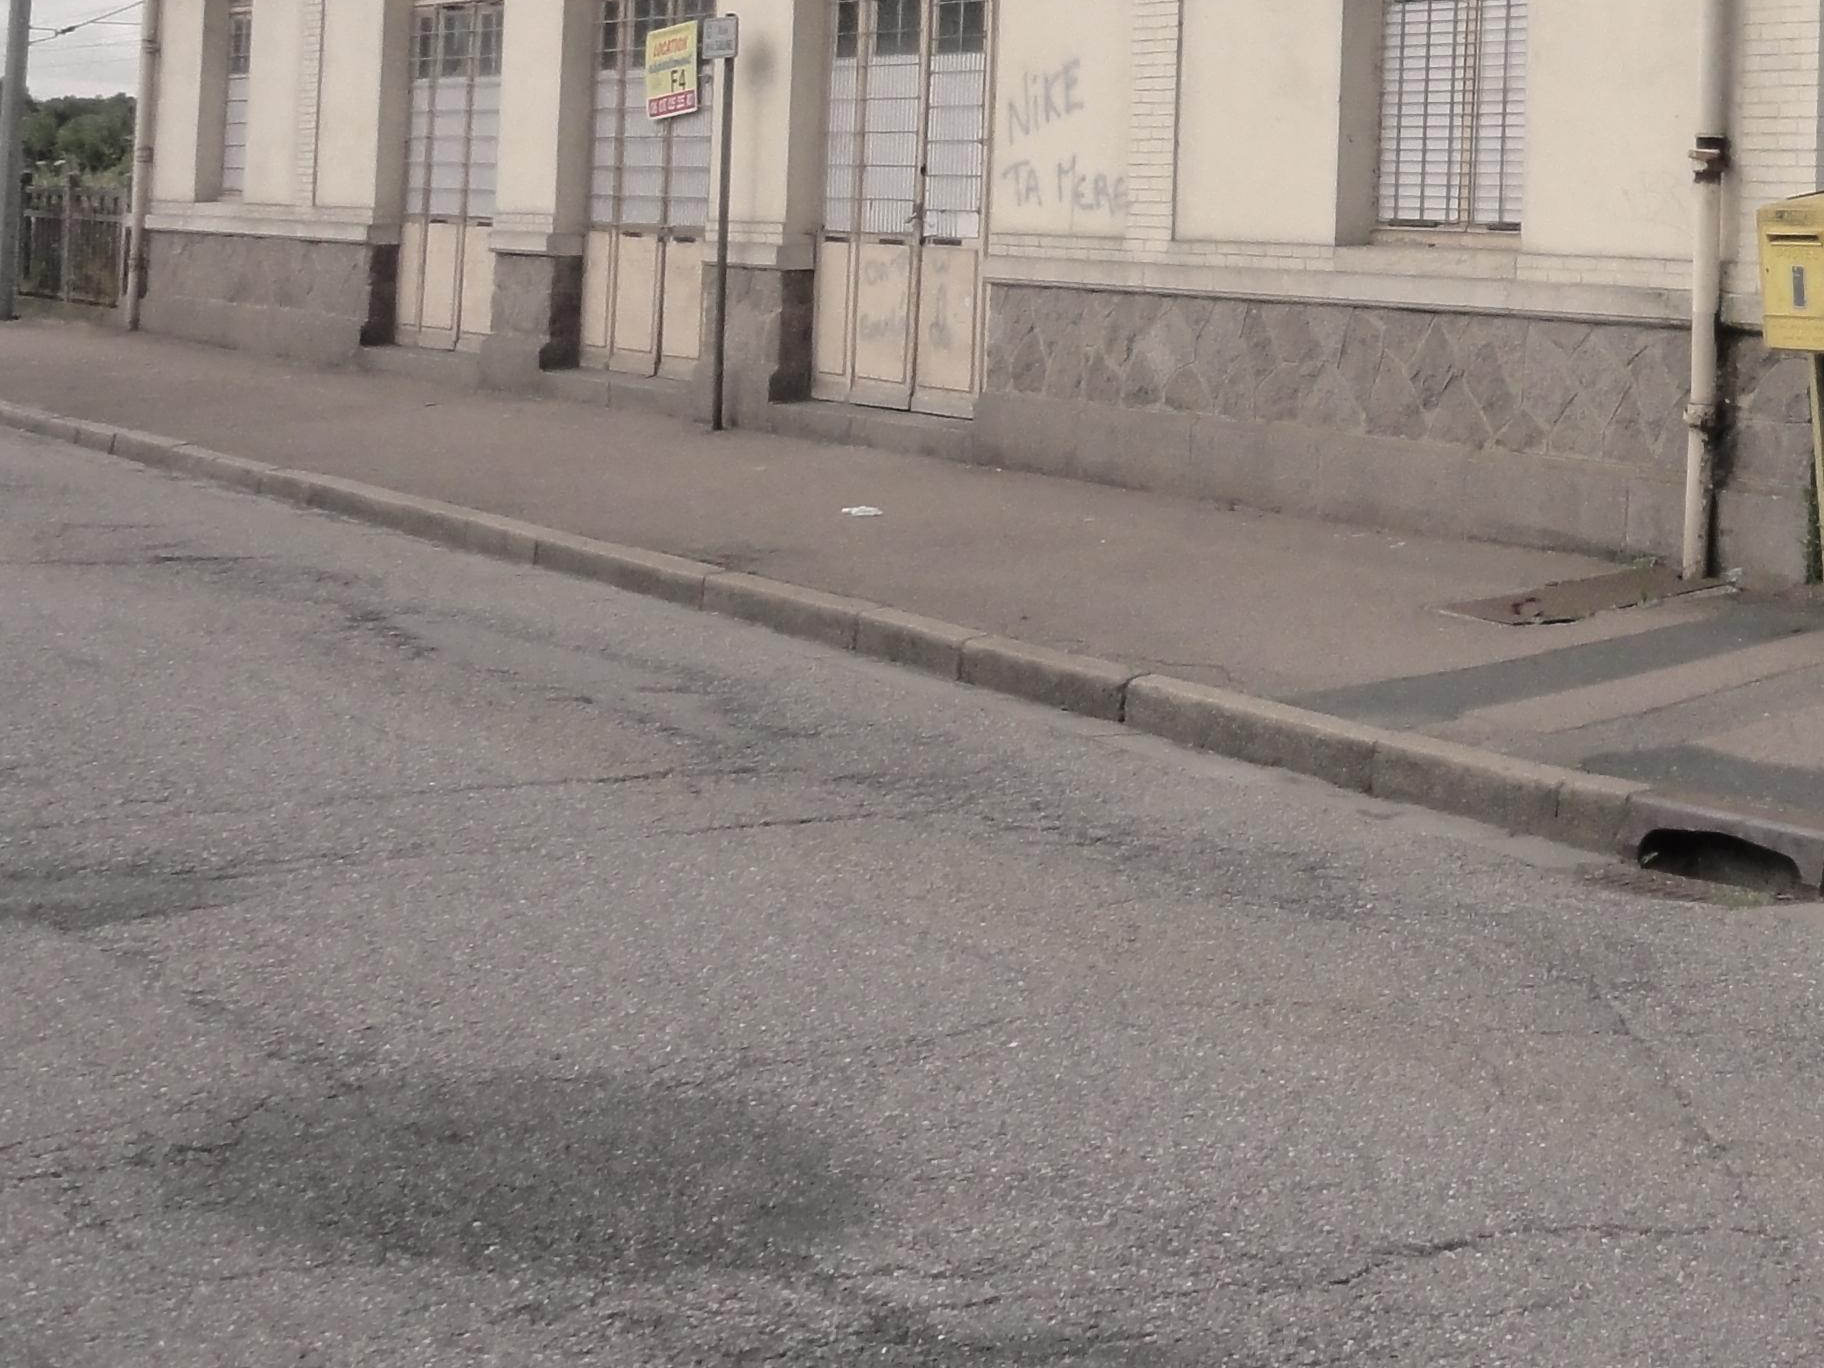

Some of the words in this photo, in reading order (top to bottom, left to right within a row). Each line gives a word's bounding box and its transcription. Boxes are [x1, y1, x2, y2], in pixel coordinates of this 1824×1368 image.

[653, 35, 689, 58] LOCATION
[670, 68, 687, 93] F4
[1002, 159, 1043, 207] TA
